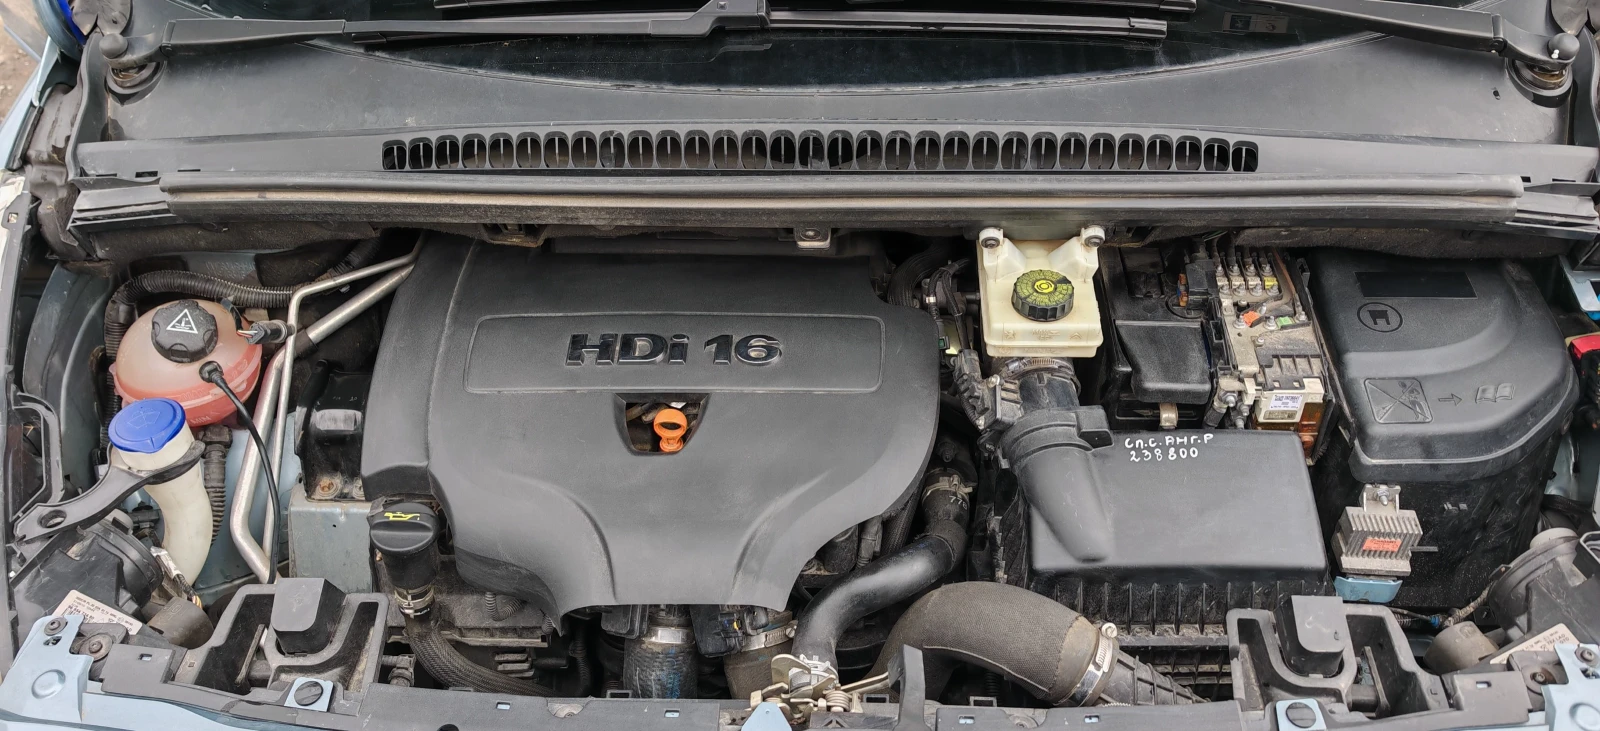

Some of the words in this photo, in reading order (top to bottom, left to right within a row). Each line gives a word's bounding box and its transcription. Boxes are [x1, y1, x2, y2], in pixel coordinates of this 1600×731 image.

[565, 333, 690, 367] HDi
[703, 334, 783, 367] 16
[190, 415, 212, 424] MIN
